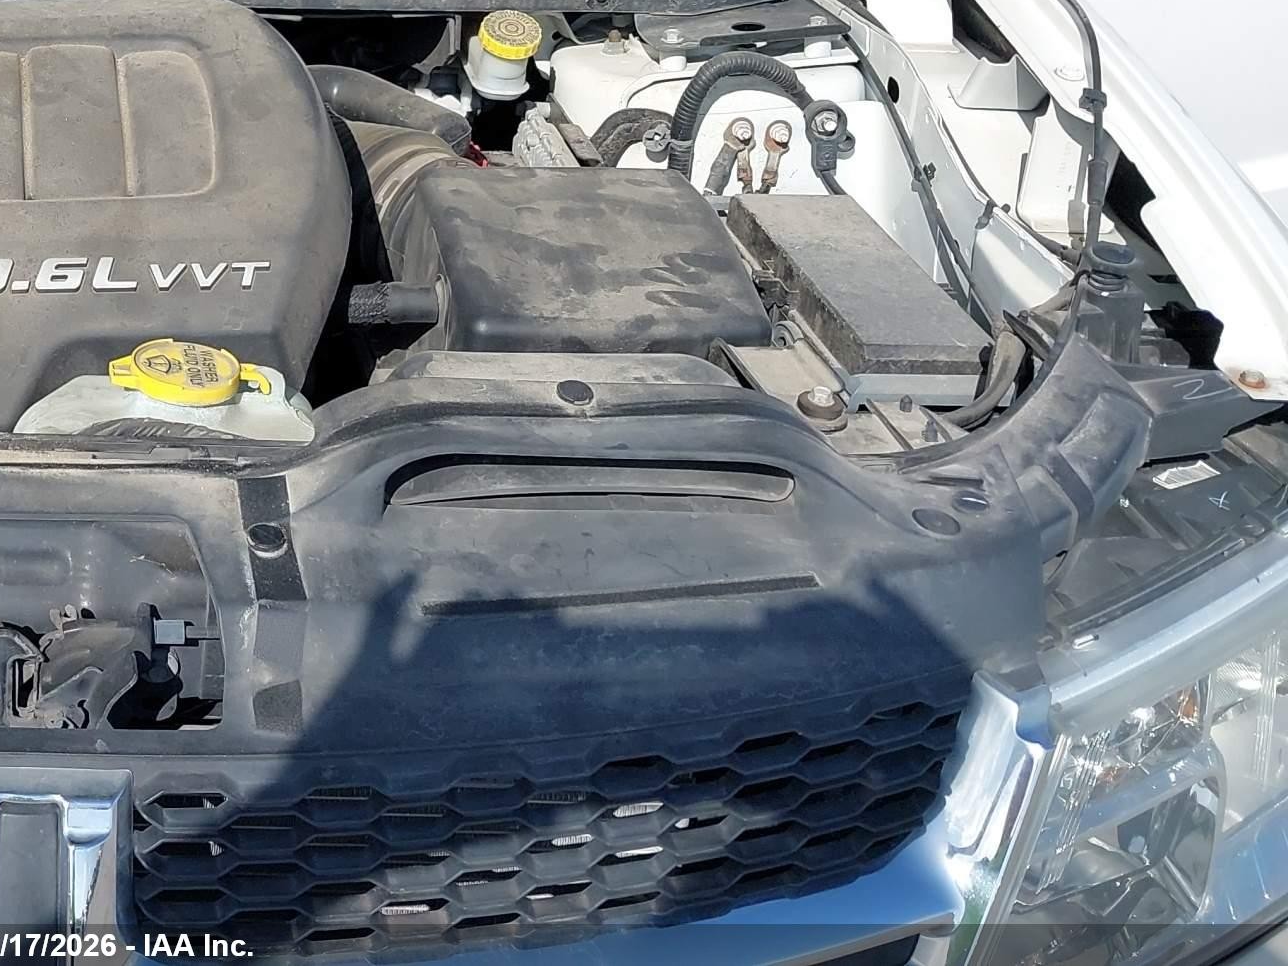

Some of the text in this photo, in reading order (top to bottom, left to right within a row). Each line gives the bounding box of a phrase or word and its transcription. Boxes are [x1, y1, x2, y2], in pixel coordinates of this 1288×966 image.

[149, 261, 271, 291] VVT
[183, 344, 205, 388] FLUID ONLY
[199, 349, 219, 383] WASHER
